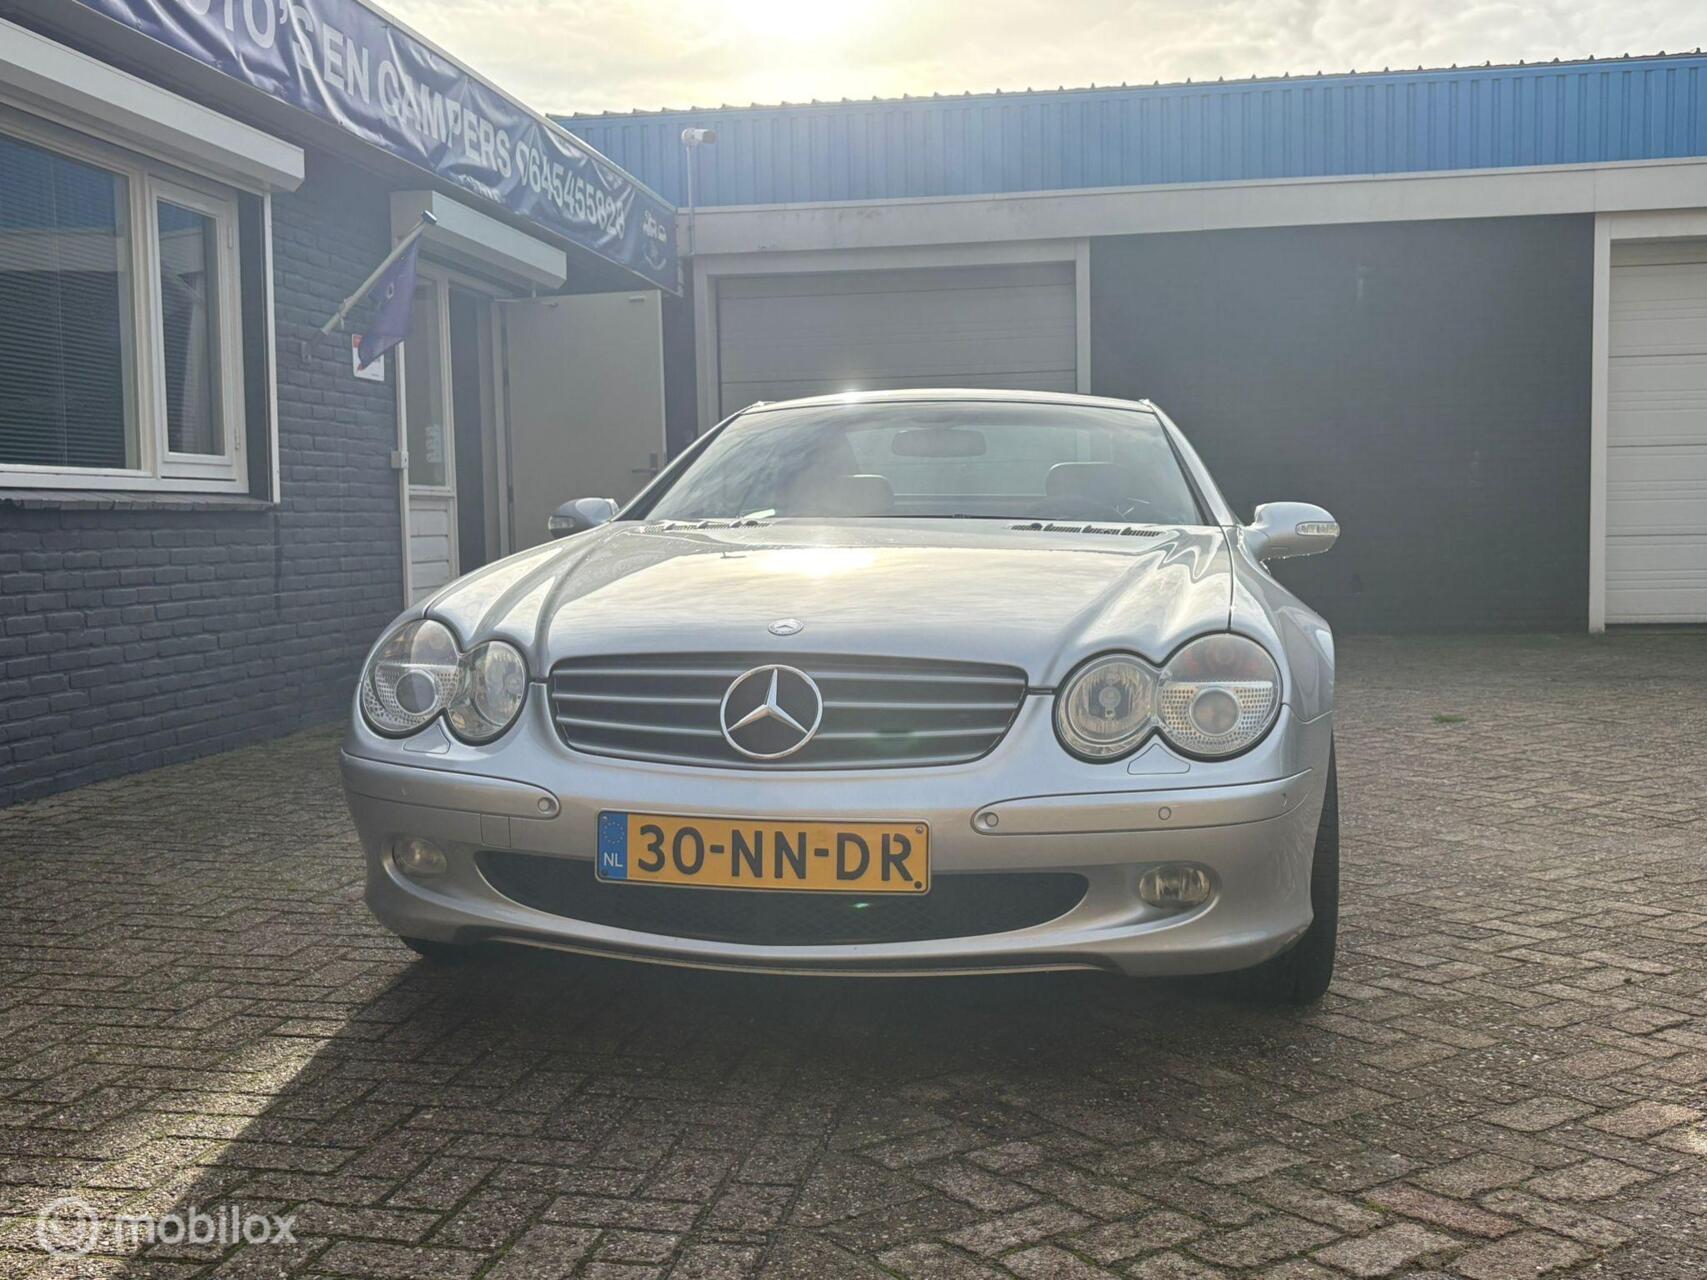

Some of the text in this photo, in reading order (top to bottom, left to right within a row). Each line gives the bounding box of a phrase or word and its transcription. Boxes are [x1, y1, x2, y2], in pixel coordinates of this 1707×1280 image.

[187, 0, 314, 70] O'S
[322, 23, 370, 104] EN
[377, 60, 513, 178] CAMPERS
[603, 852, 624, 868] NL
[637, 824, 914, 882] 30-NN-DR
